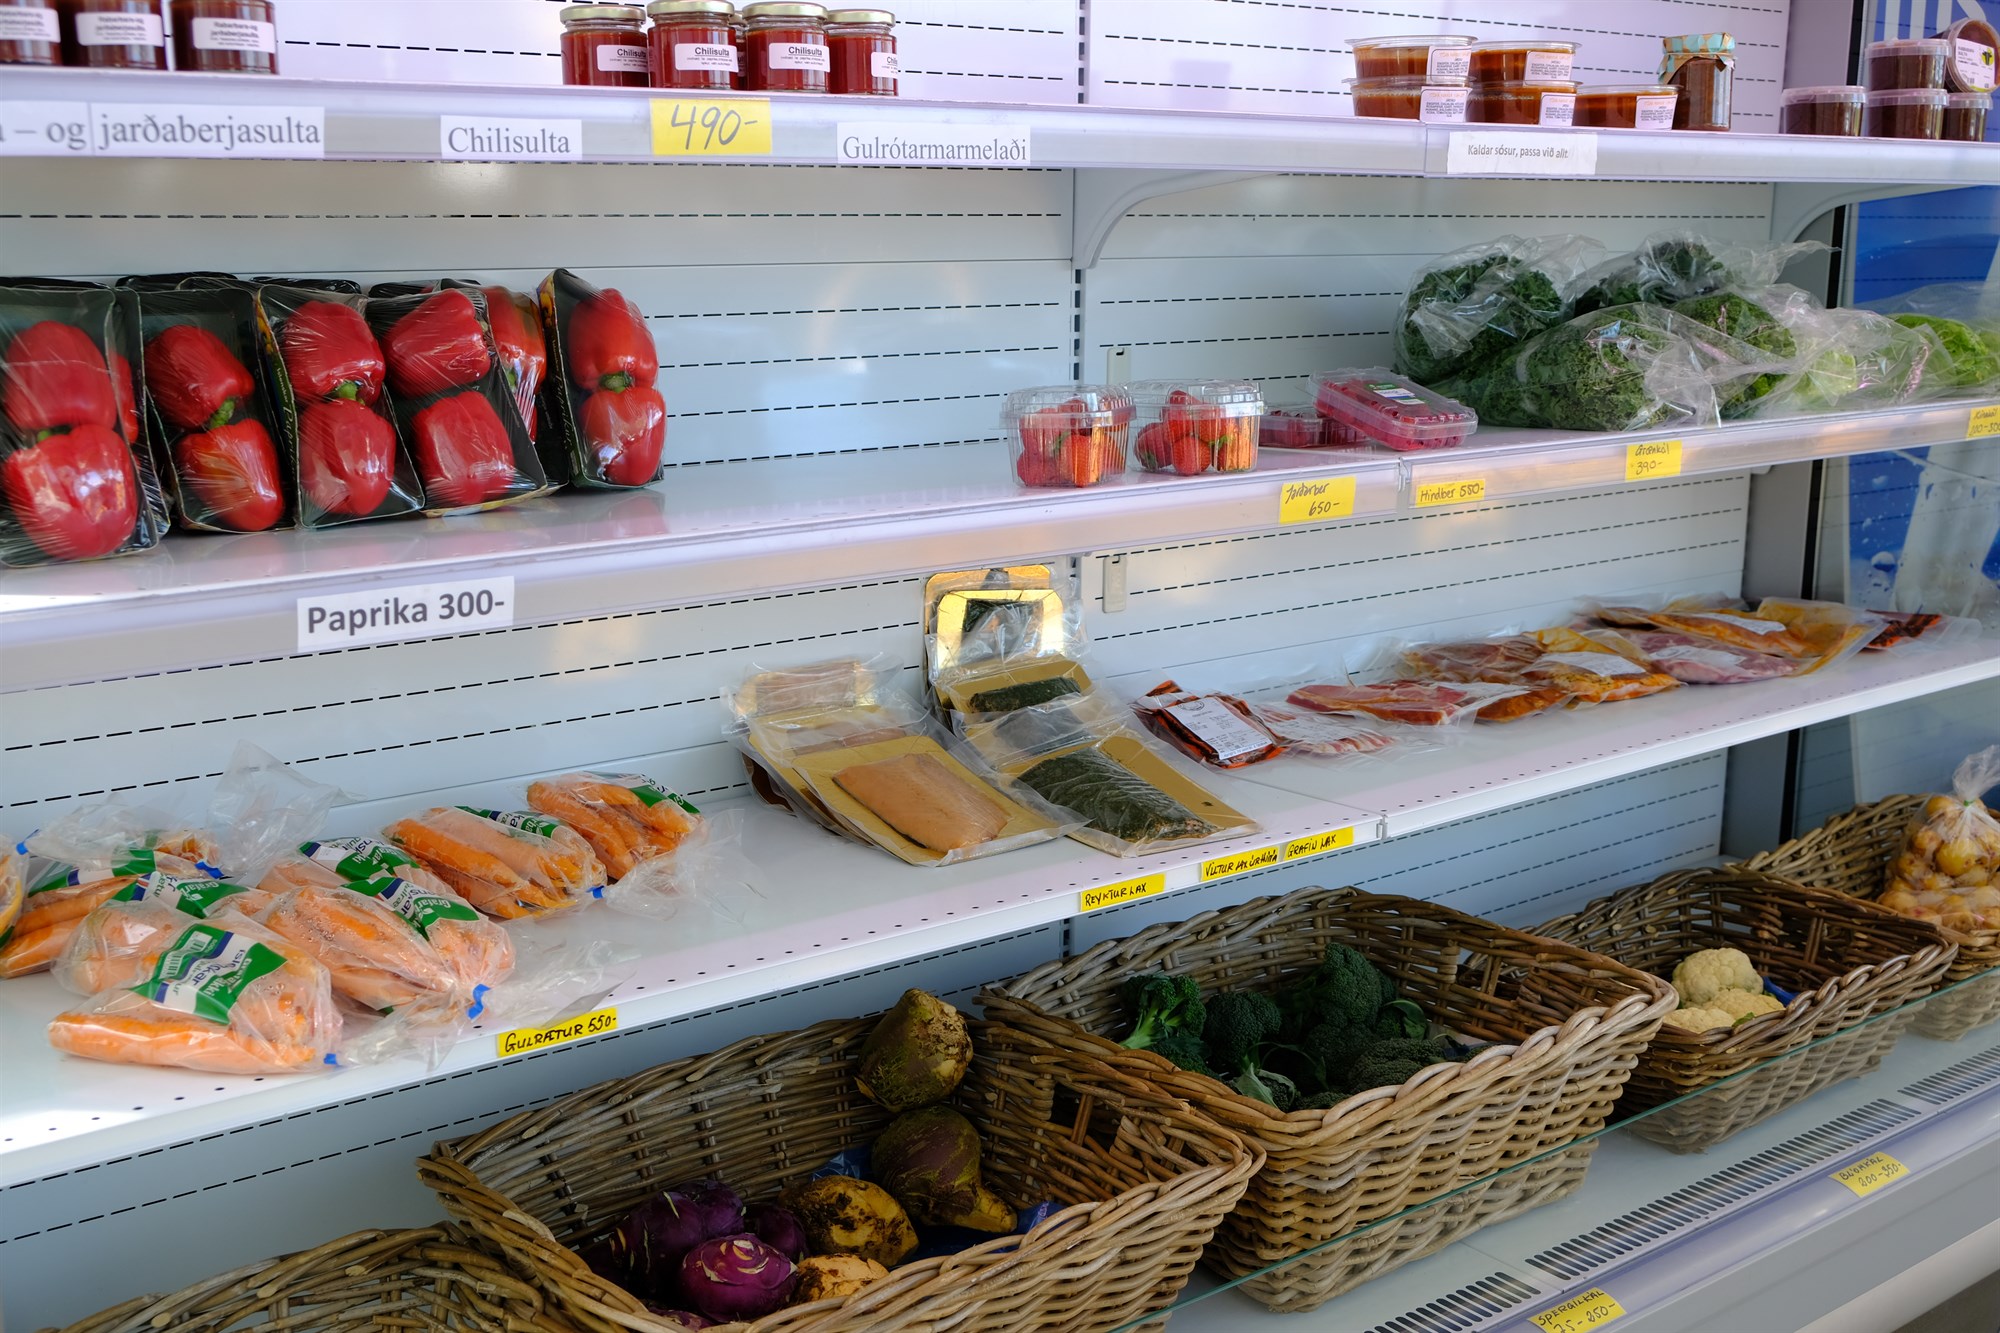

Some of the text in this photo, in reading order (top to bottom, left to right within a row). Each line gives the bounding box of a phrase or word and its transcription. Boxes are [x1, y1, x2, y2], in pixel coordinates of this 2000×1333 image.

[694, 47, 730, 56] Chilisulta
[788, 46, 822, 56] Chilisulta
[46, 122, 86, 149] og
[98, 113, 321, 151] jarðaberjasulta
[670, 103, 758, 151] 490-
[447, 126, 571, 154] Chilisulta
[843, 136, 1027, 160] Gulrótarmarmelaði
[1468, 144, 1493, 156] Kaldar
[1494, 144, 1518, 158] sósur,
[1519, 148, 1541, 159] passa
[1542, 147, 1554, 158] við
[1420, 487, 1456, 502] Hindber
[1309, 501, 1340, 516] 650-
[308, 589, 505, 636] Paprika 300-
[1320, 834, 1336, 850] LAX
[1085, 882, 1147, 906] REYKTUR LAX
[505, 1023, 583, 1053] GULRÆTUR
